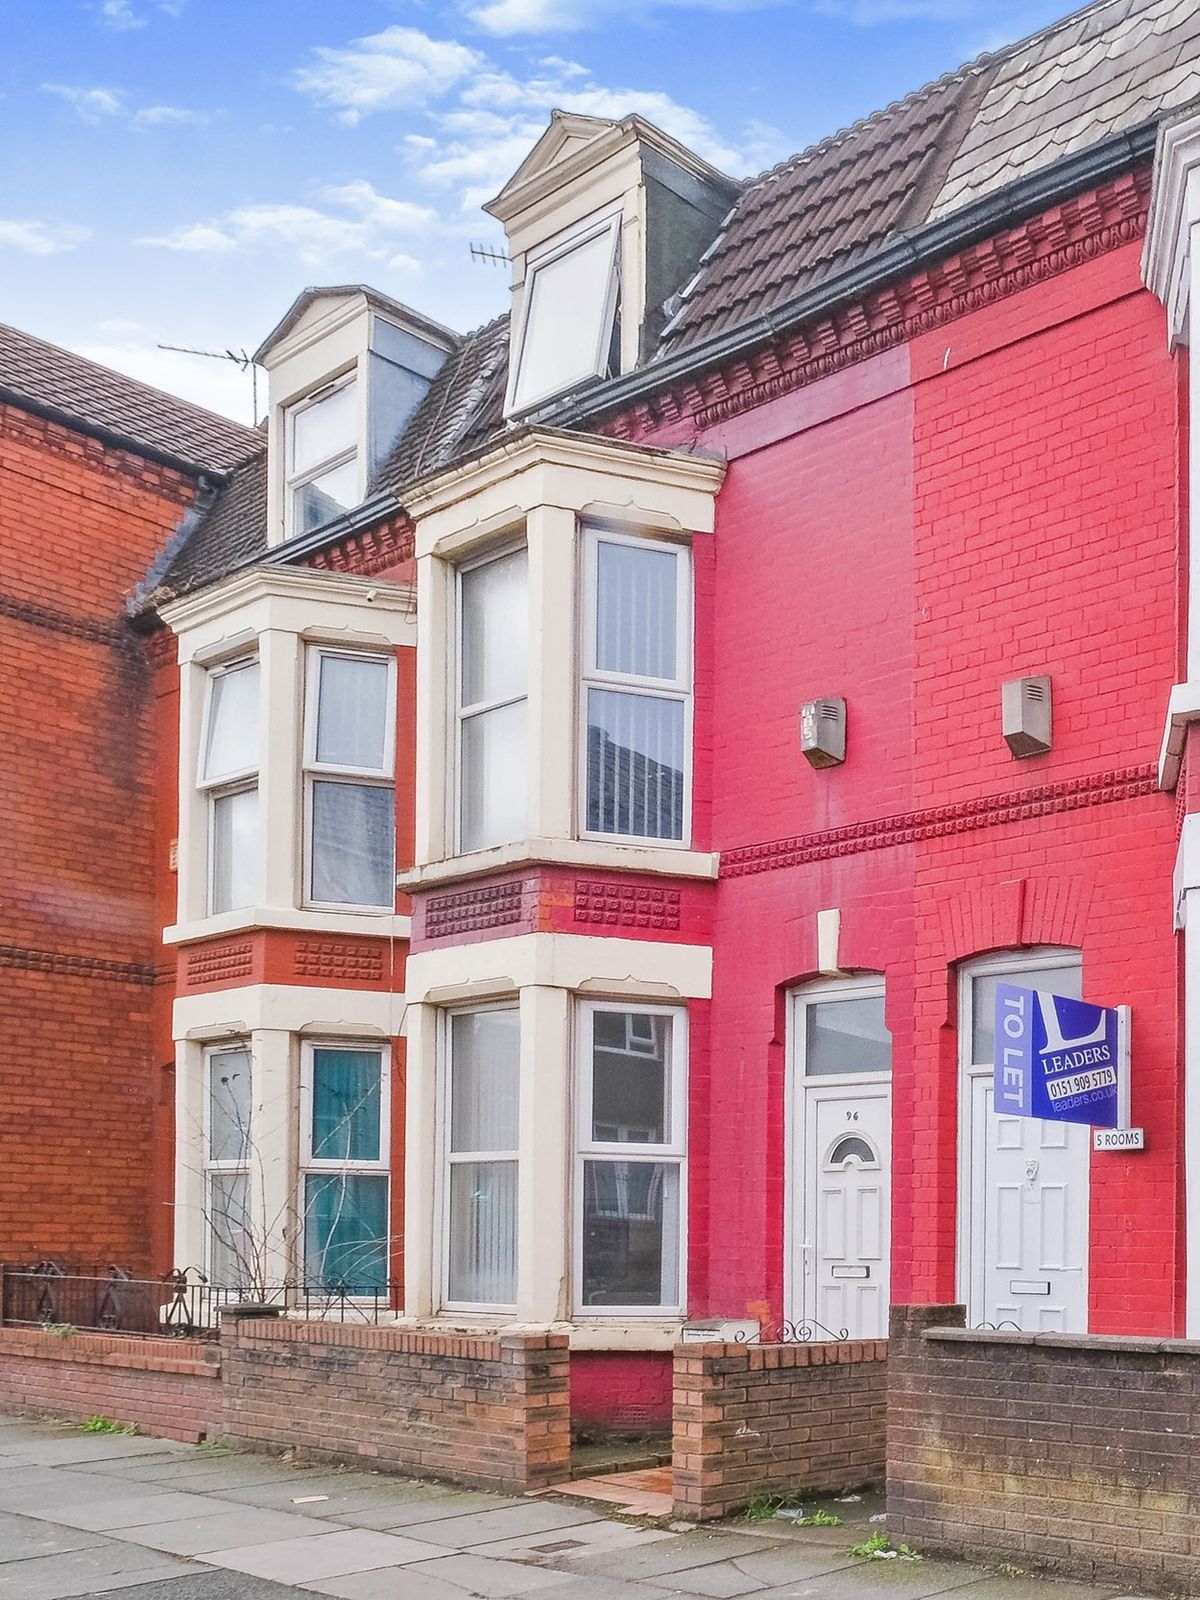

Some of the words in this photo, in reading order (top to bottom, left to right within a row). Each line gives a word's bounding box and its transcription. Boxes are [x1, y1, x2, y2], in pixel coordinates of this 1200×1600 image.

[1003, 995, 1025, 1039] TO
[1041, 1045, 1111, 1075] LEADERS
[1003, 1048, 1024, 1108] LET
[1050, 1080, 1073, 1098] 0151
[1074, 1075, 1091, 1092] 909
[1092, 1069, 1113, 1087] 5779
[1052, 1085, 1117, 1113] leaders.co.uk
[846, 1111, 859, 1121] 96
[1105, 1132, 1140, 1146] ROOMS
